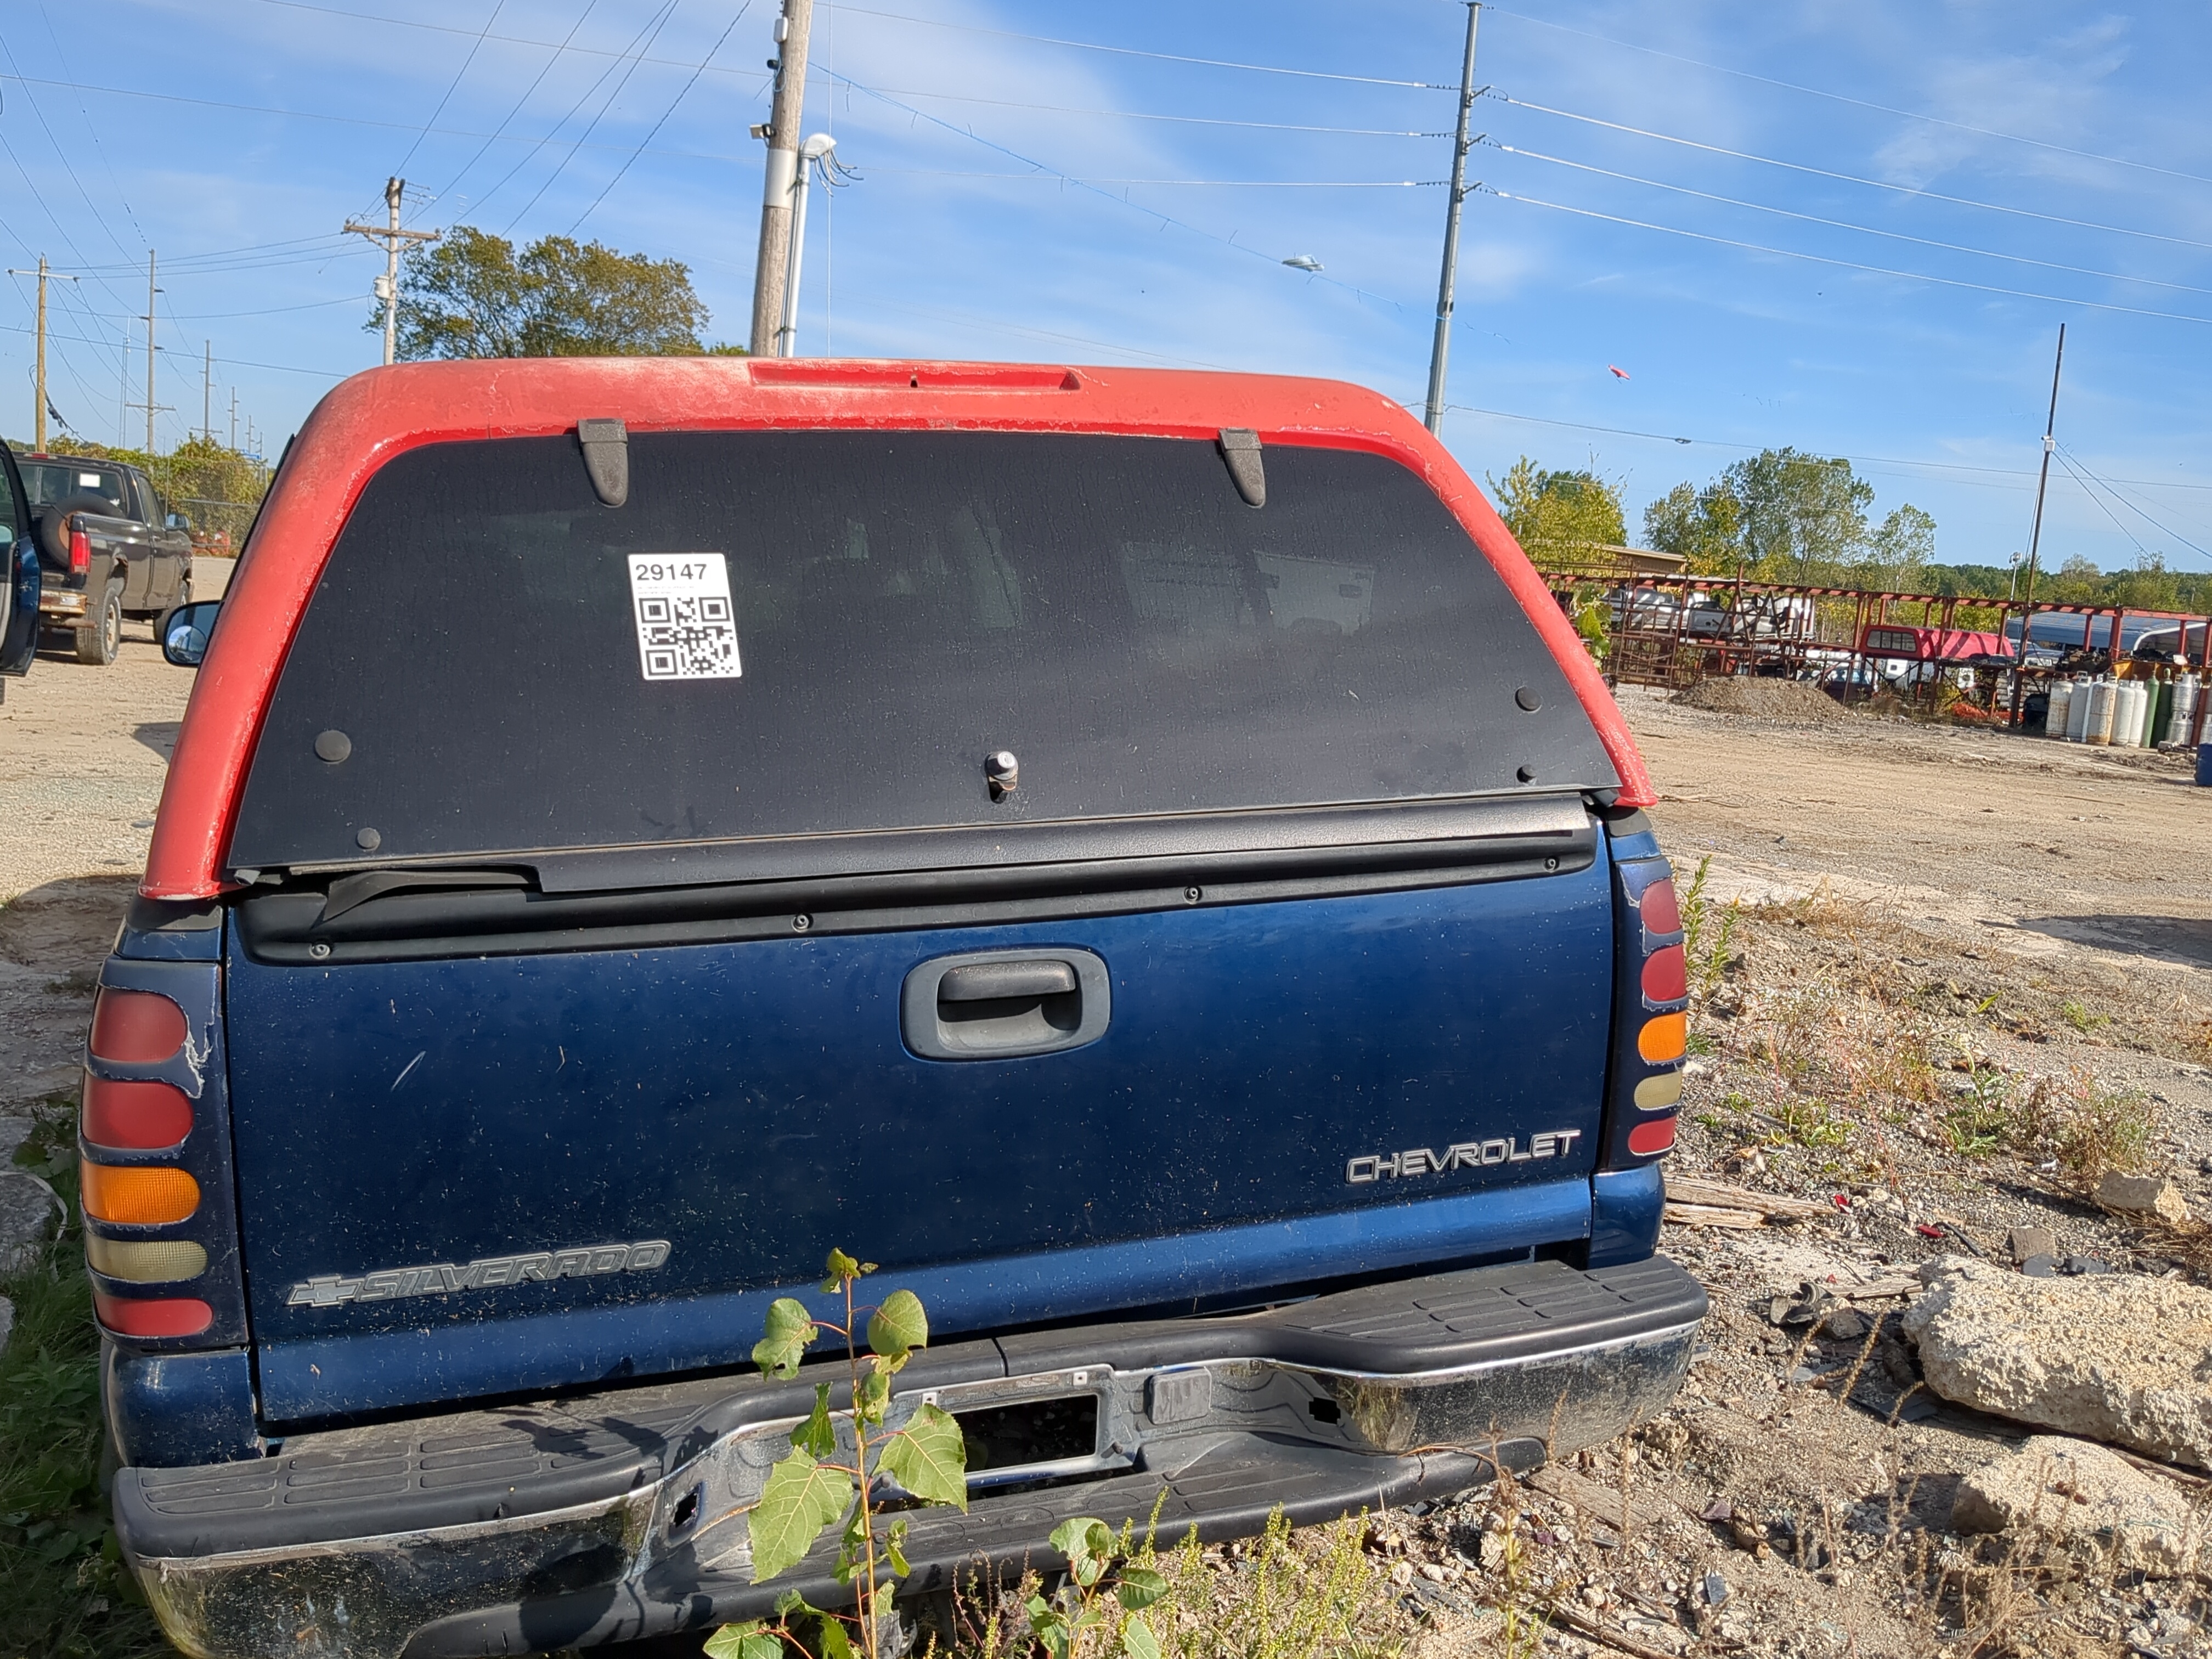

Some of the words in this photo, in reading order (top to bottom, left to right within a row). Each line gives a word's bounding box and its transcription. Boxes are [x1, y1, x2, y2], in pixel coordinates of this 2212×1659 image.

[635, 563, 707, 581] 29147
[1346, 1128, 1581, 1184] CHEVROLET
[353, 1240, 672, 1303] SILVERADO
